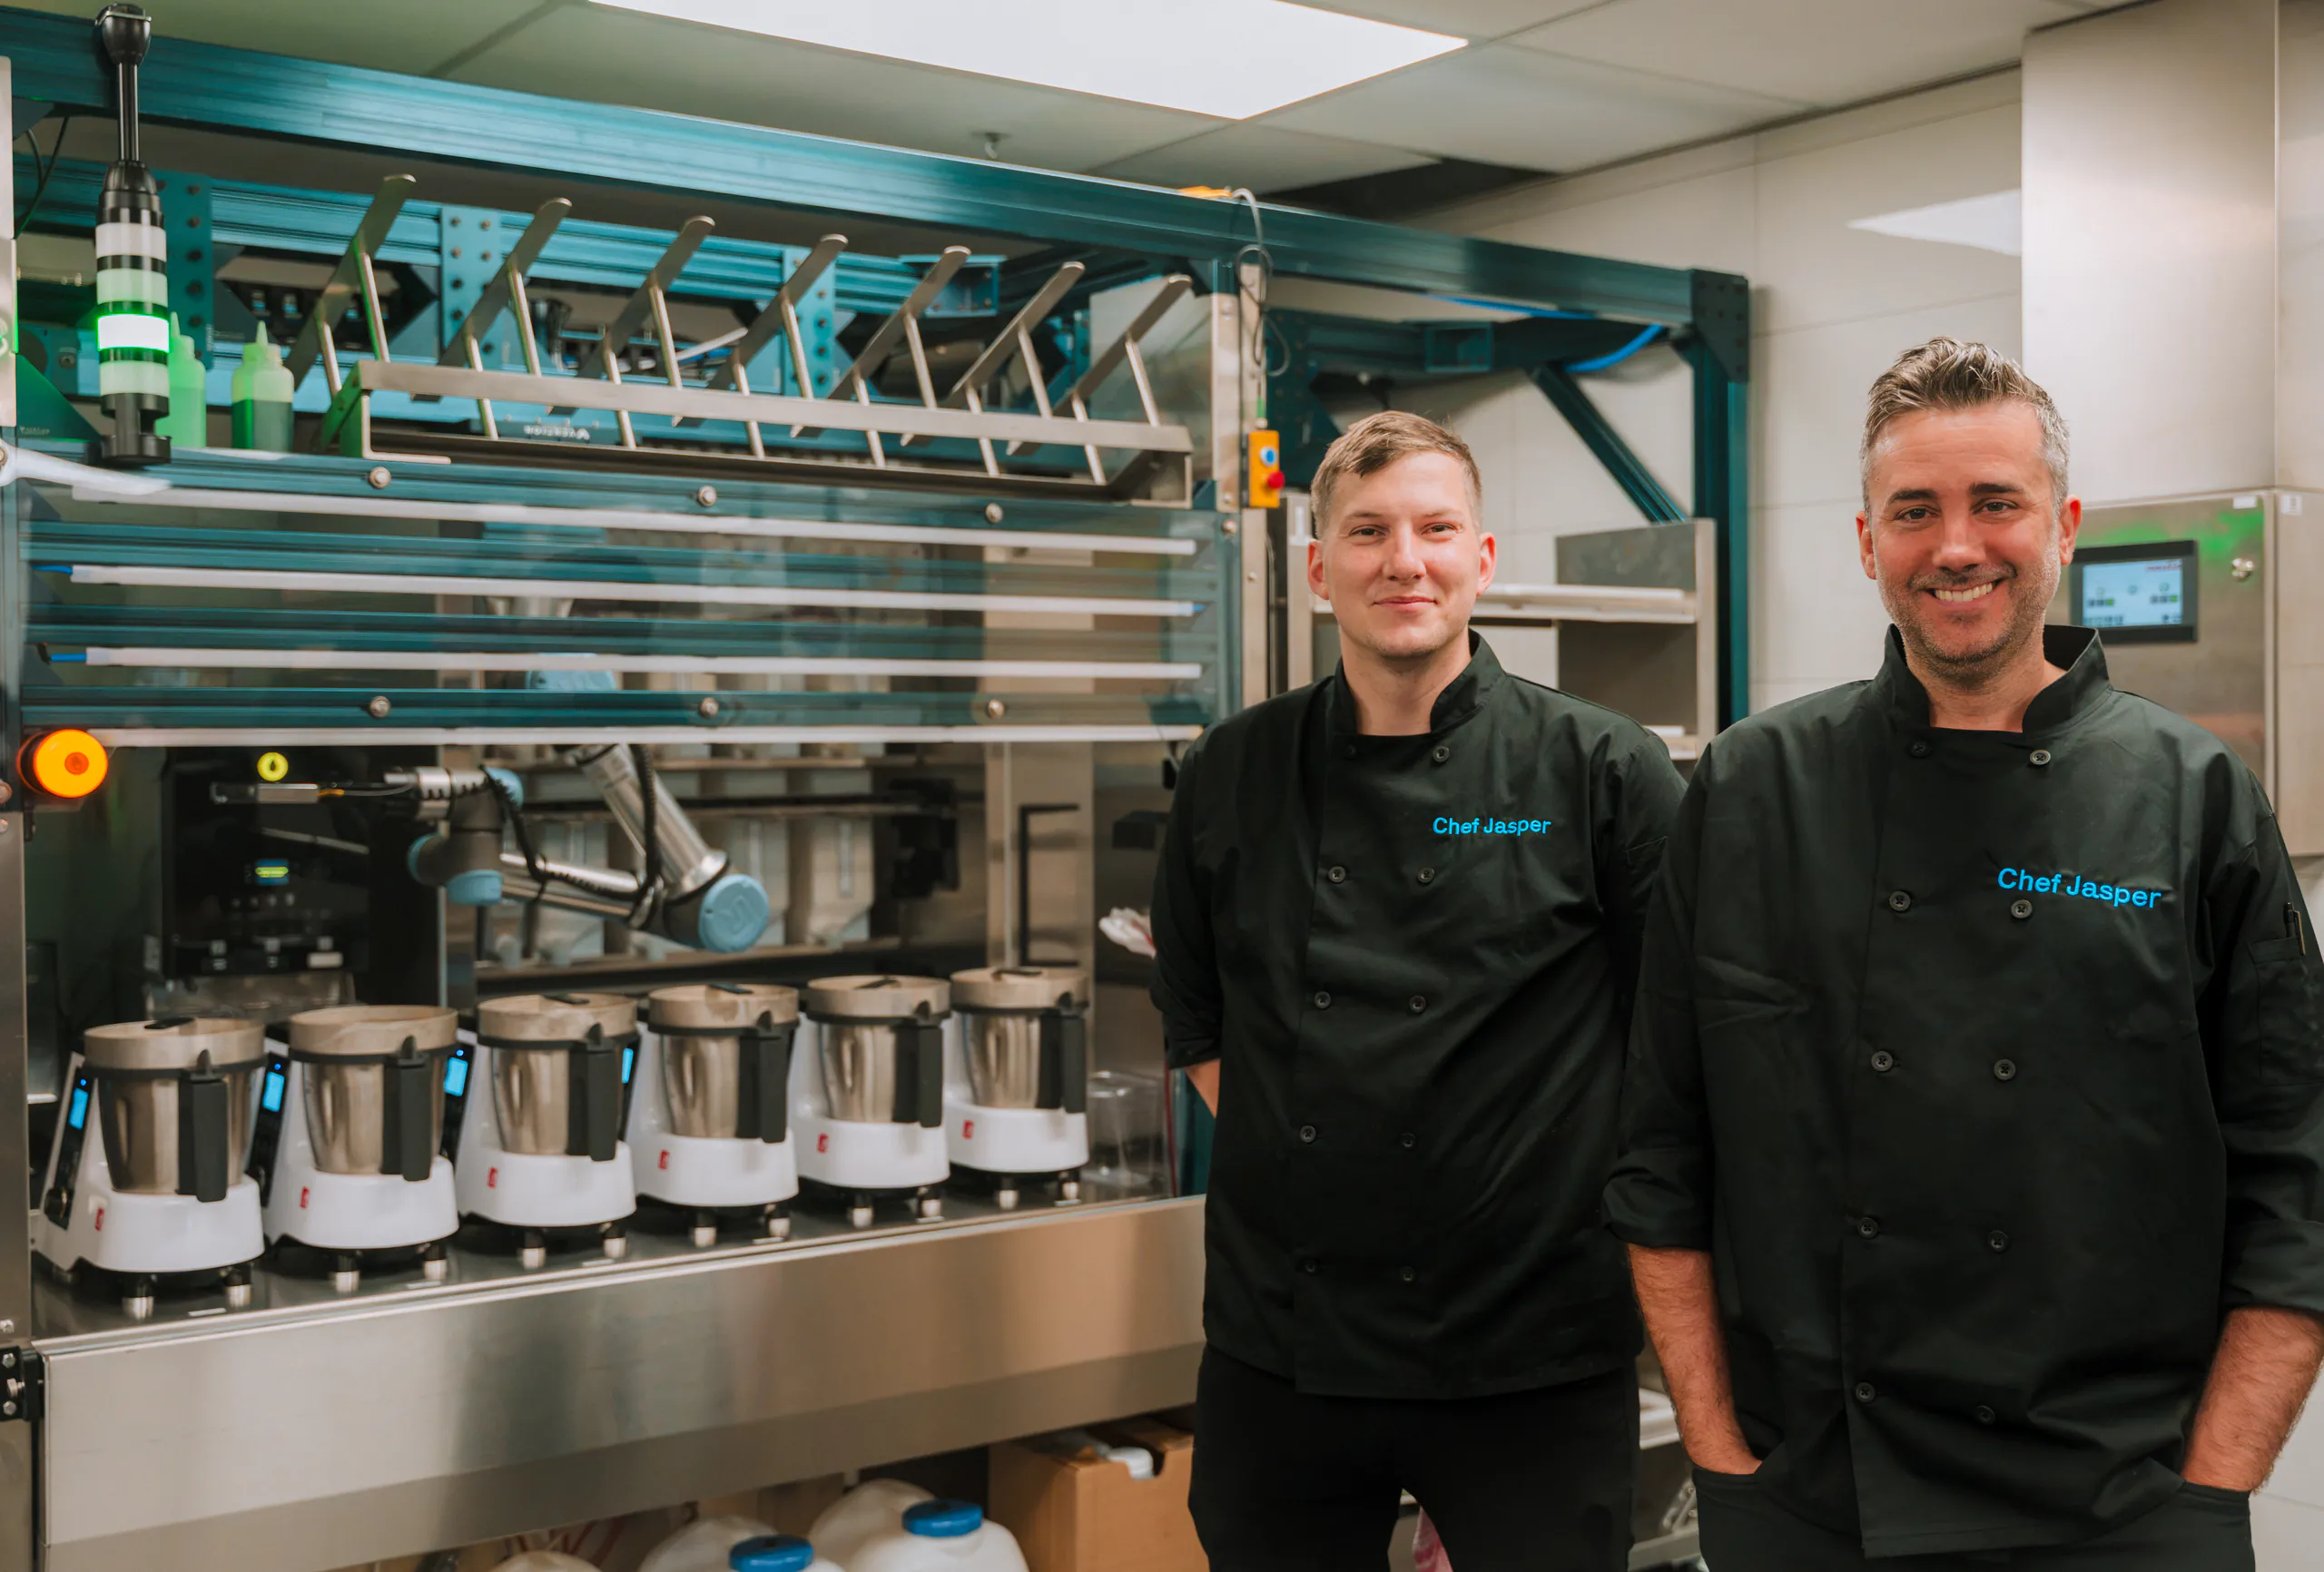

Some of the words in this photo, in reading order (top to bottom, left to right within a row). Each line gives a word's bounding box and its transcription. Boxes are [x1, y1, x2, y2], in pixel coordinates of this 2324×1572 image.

[1433, 816, 1480, 835] Chef
[1482, 817, 1552, 837] Jasper
[1997, 867, 2063, 894] Chef
[2065, 874, 2163, 909] Jasper
